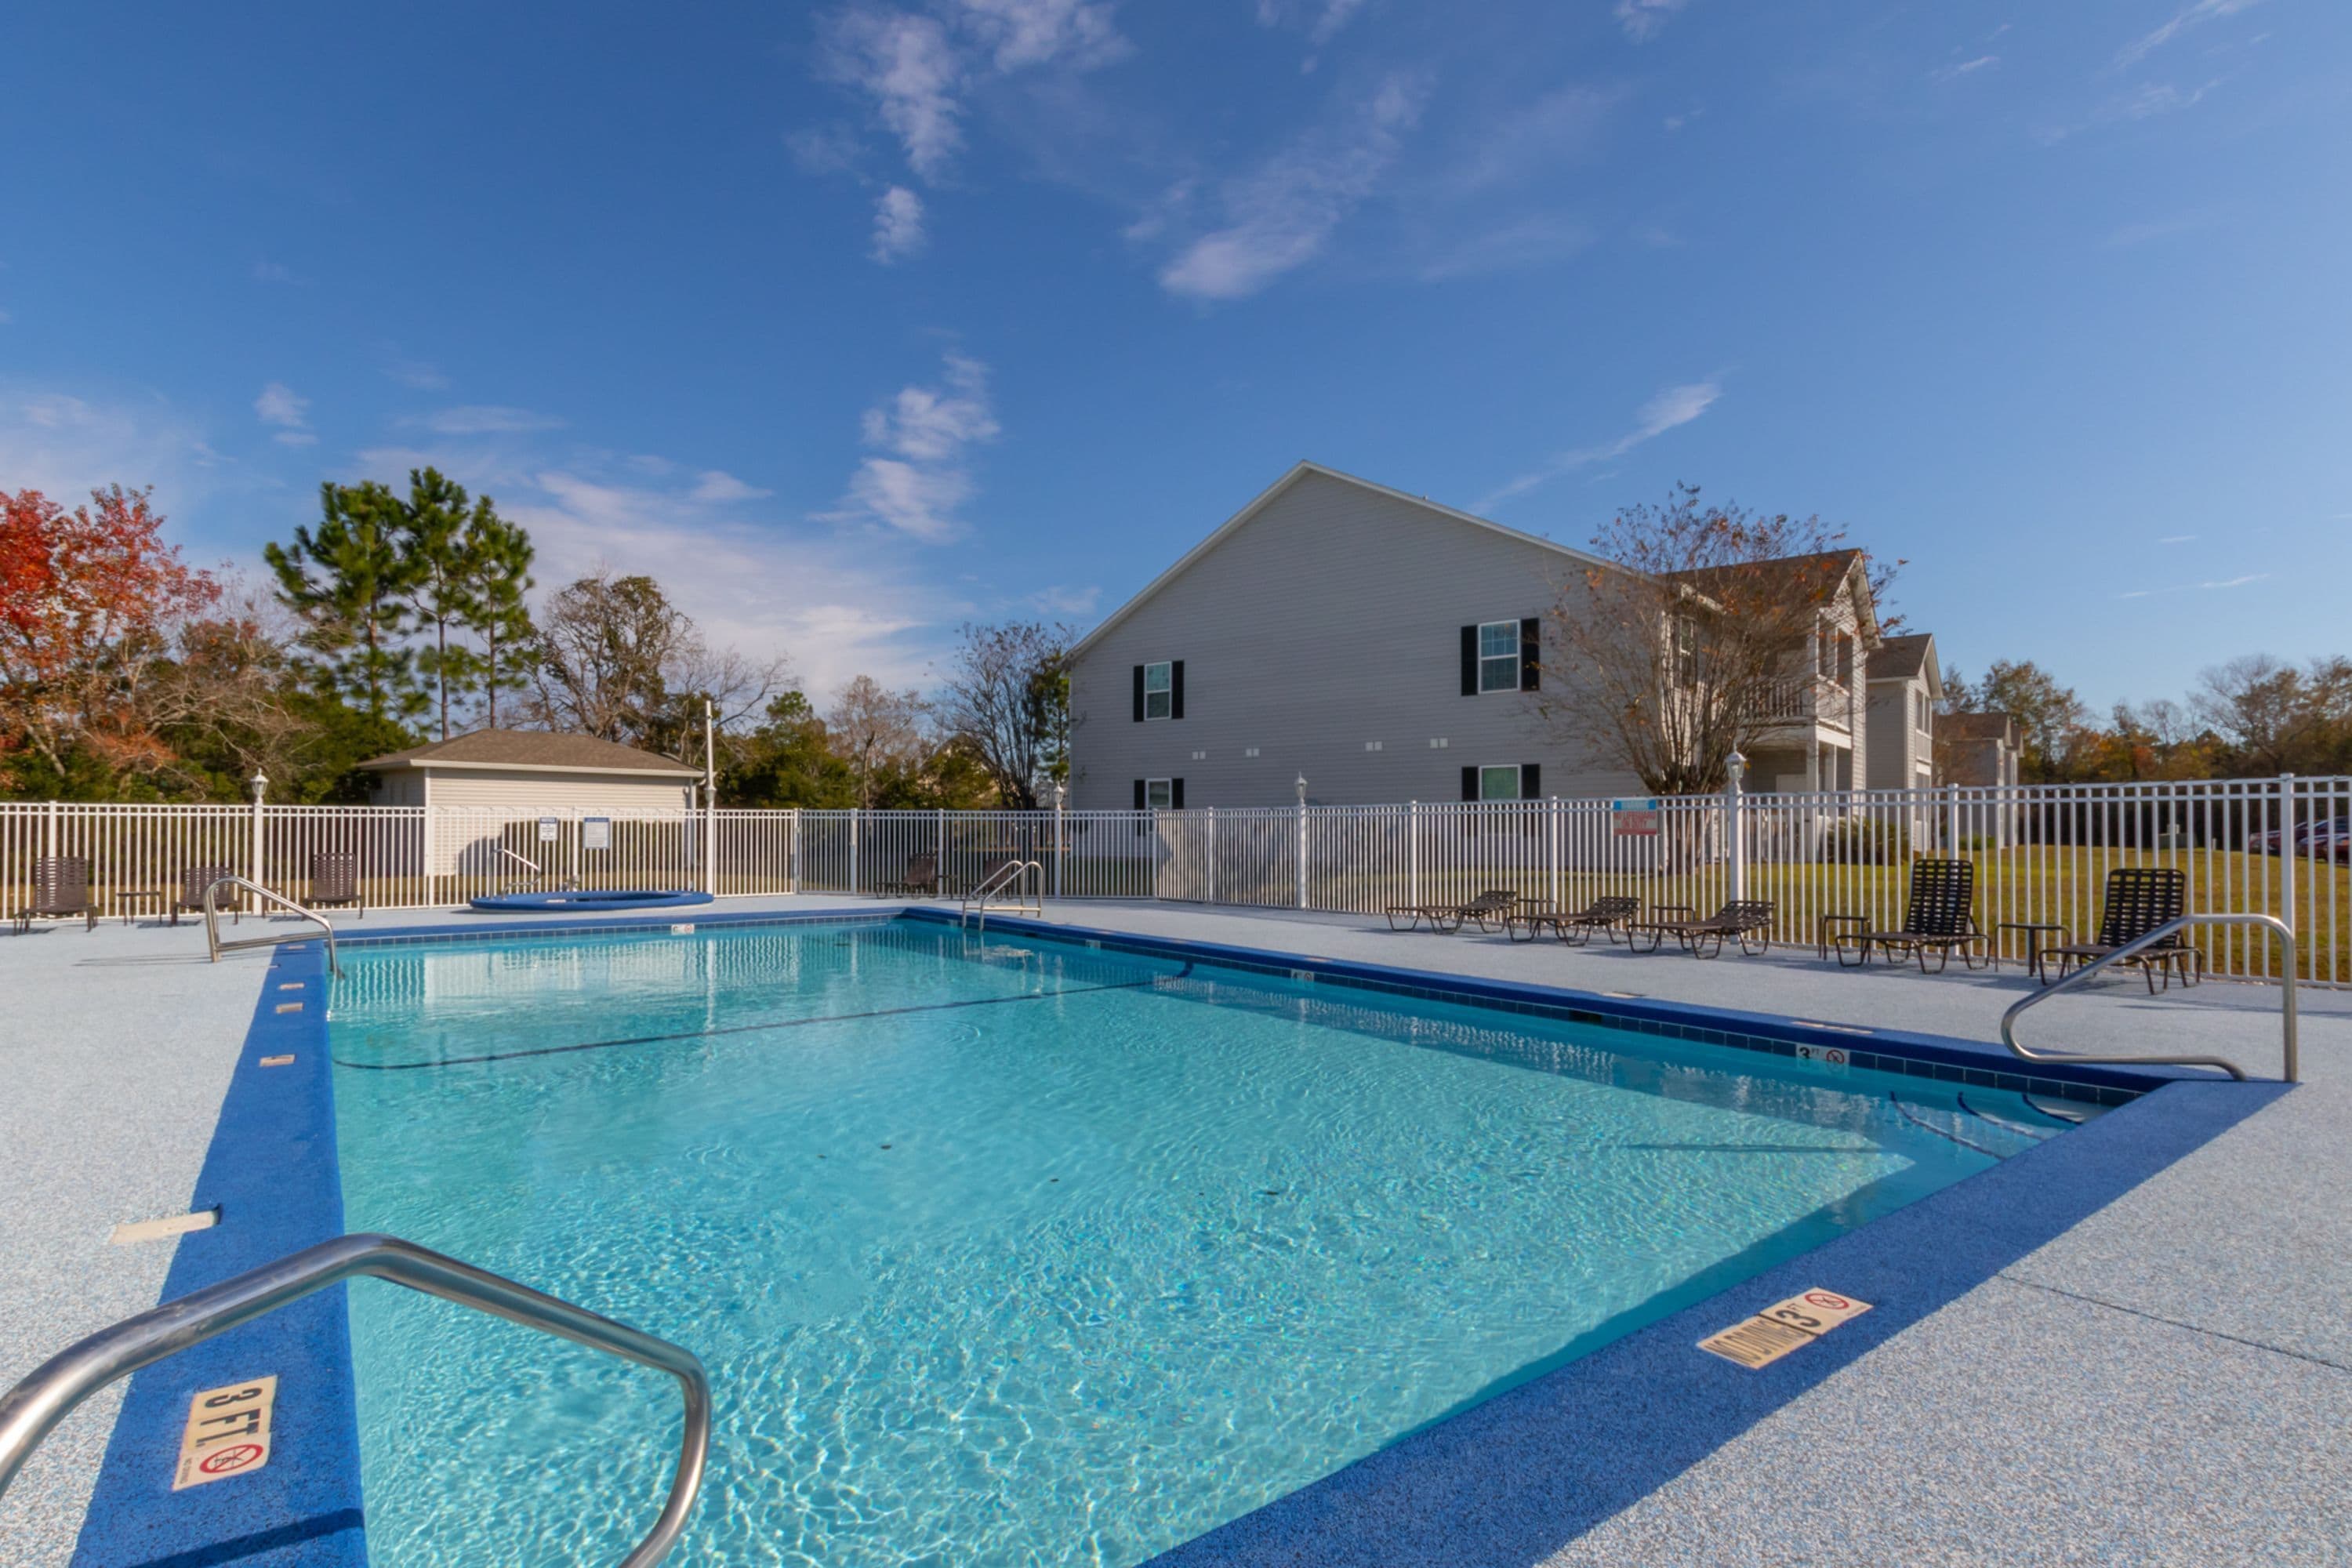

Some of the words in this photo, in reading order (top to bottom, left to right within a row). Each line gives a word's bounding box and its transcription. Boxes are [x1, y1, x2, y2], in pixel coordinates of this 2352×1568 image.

[1787, 1303, 1806, 1312] FT
[1775, 1309, 1821, 1327] 3
[205, 1387, 263, 1408] 3
